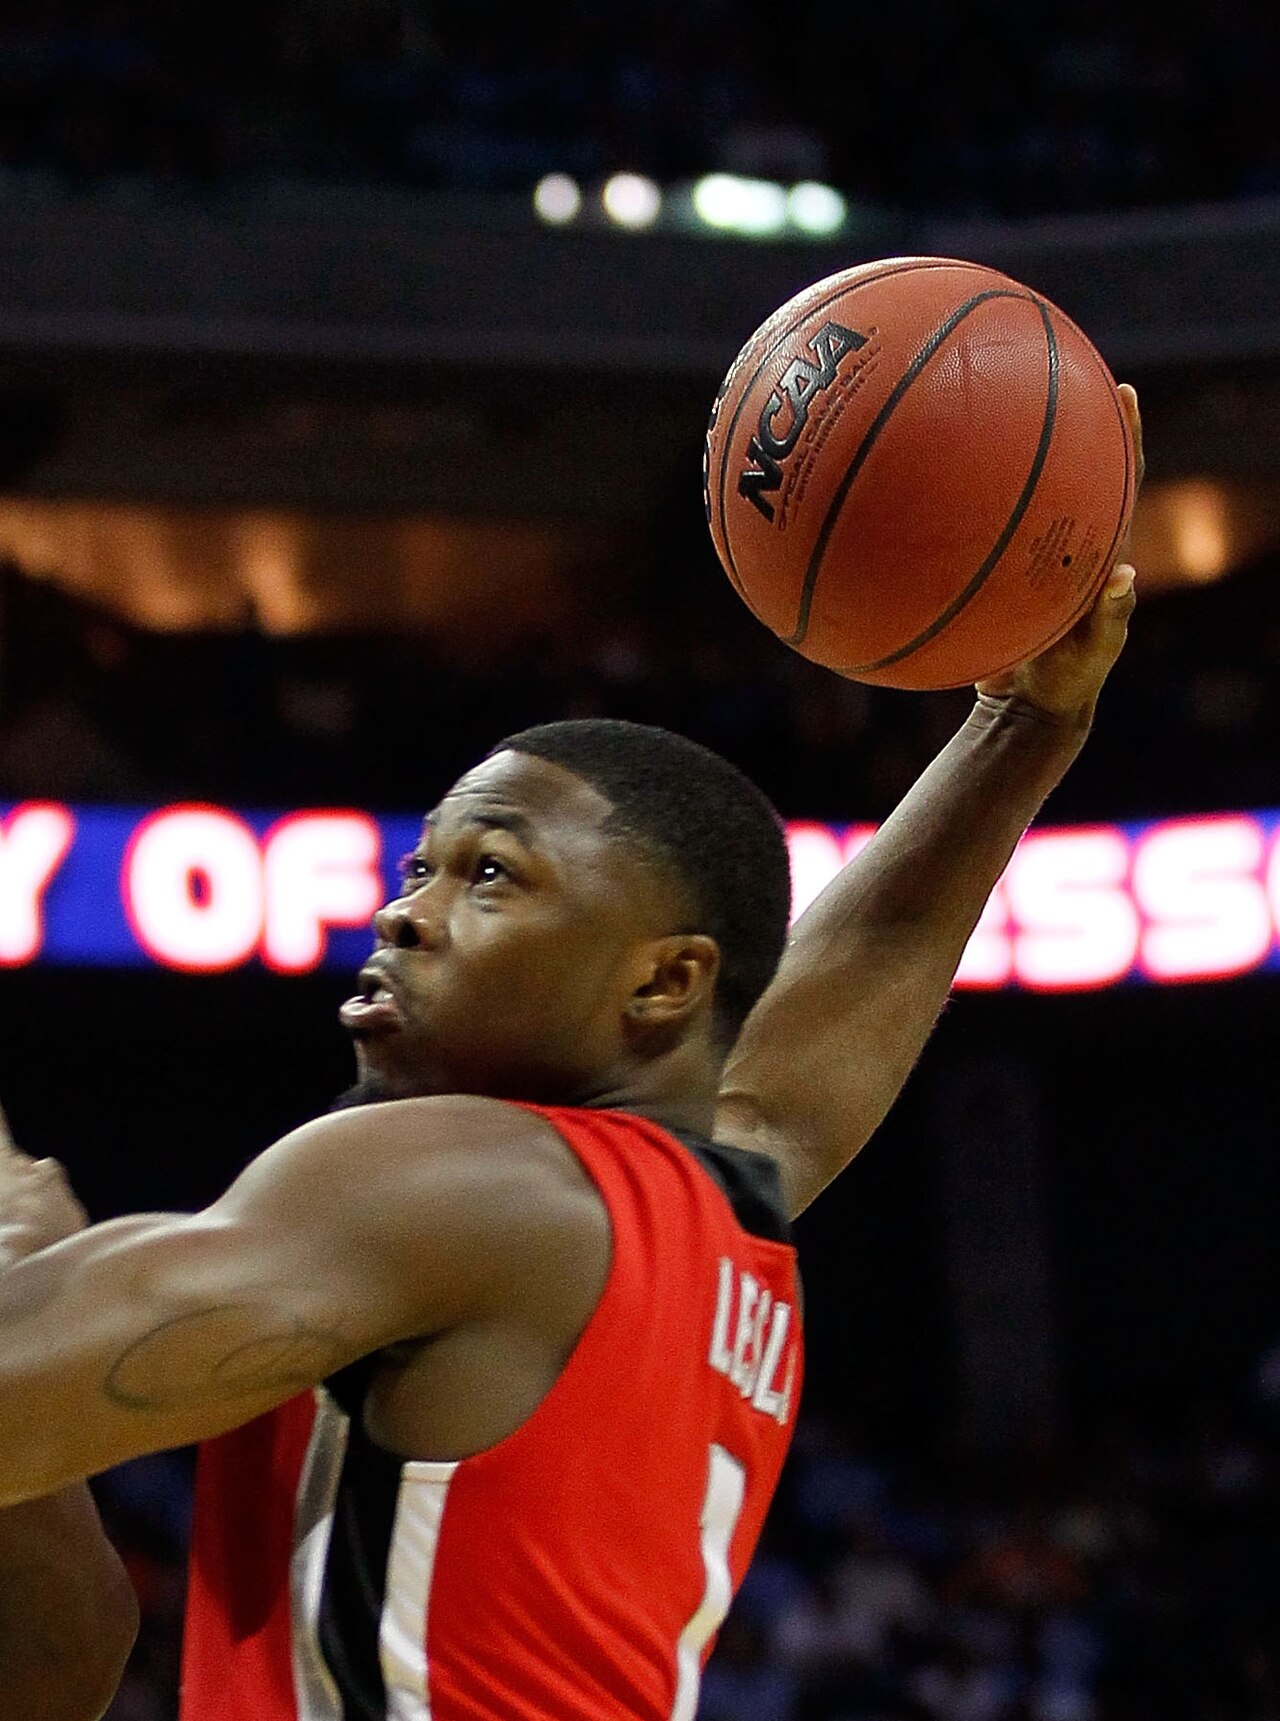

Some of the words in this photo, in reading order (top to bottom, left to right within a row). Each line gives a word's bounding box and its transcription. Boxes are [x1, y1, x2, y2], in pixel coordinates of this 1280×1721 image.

[738, 322, 870, 523] NCAA
[125, 801, 383, 975] OF
[708, 1256, 798, 1426] LESL
